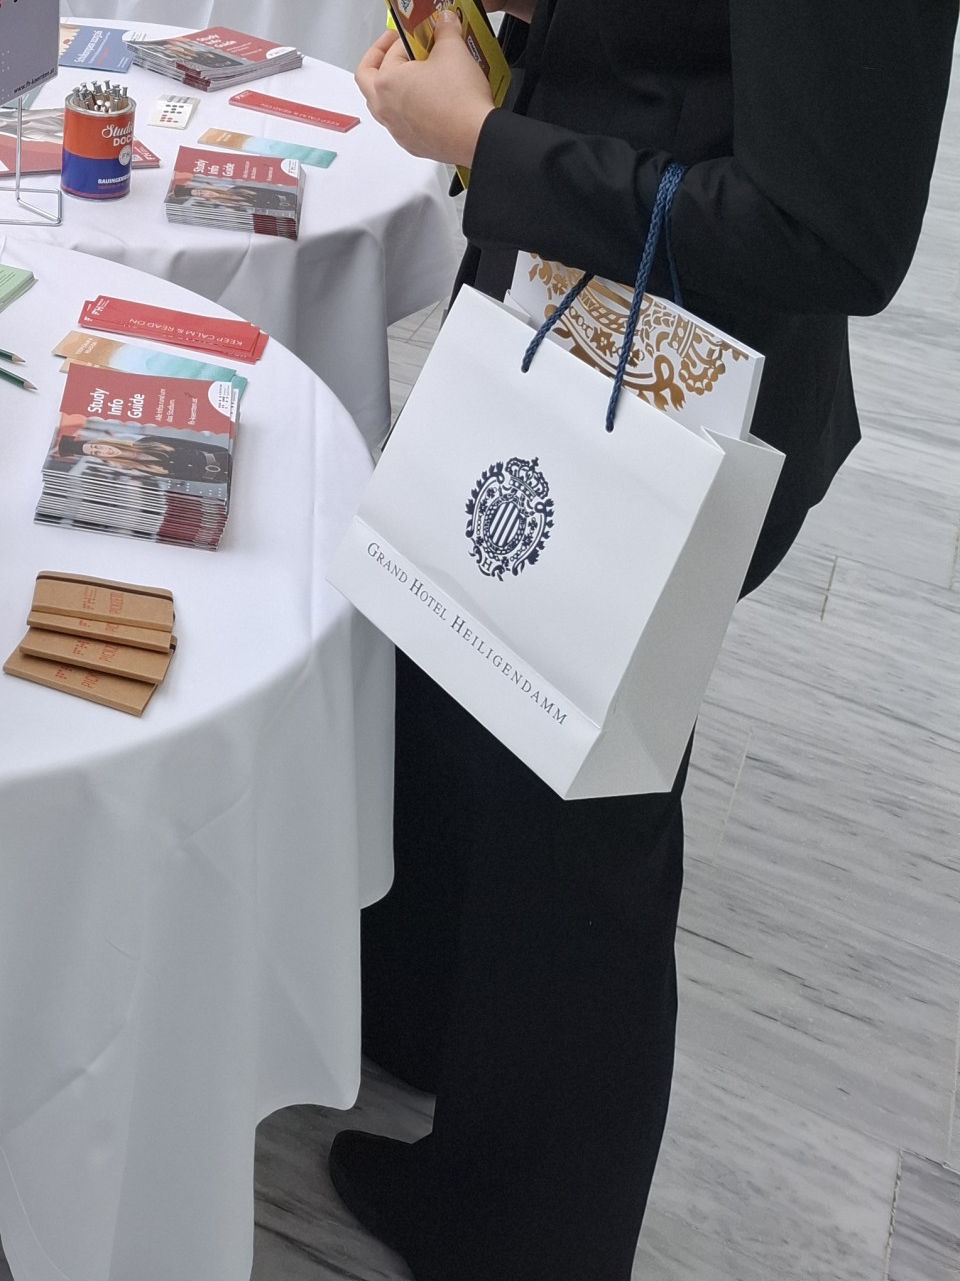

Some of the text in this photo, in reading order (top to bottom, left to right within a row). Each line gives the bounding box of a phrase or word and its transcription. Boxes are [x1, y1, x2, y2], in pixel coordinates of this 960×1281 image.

[129, 318, 146, 326] ON
[147, 322, 174, 332] READ
[185, 330, 216, 340] CALM
[217, 337, 243, 346] KEEP
[88, 387, 110, 414] Study
[108, 398, 124, 417] Info
[128, 393, 145, 419] Guide
